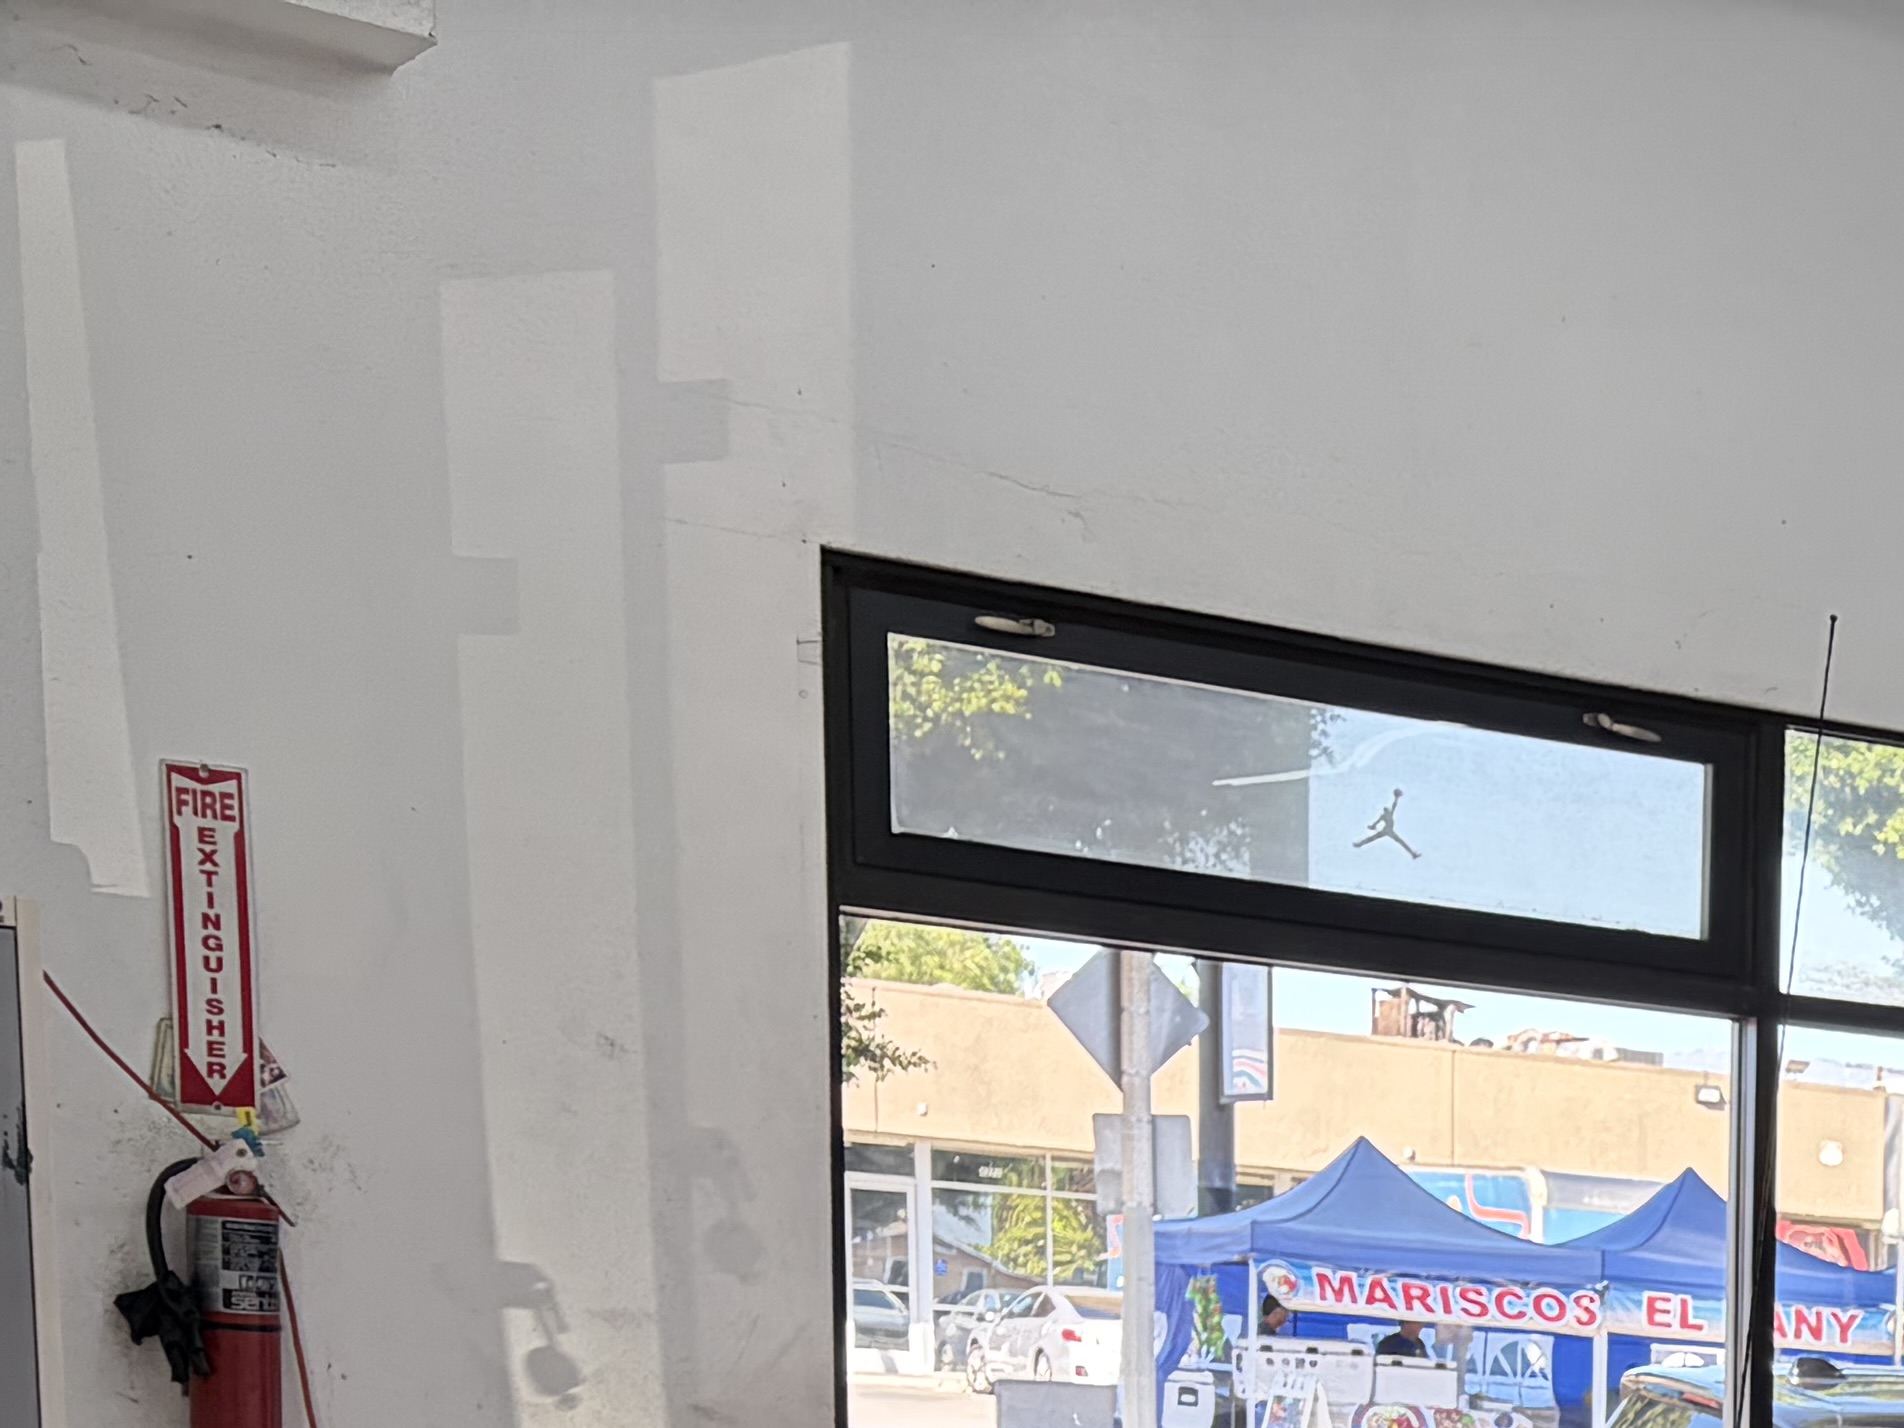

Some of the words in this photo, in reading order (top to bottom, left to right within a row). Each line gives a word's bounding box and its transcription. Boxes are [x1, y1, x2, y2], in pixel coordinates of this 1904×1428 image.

[175, 786, 237, 823] FIRE
[197, 826, 228, 1080] EXTINGUISHER
[1315, 1272, 1599, 1327] MARISCOS
[1646, 1293, 1705, 1332] EL
